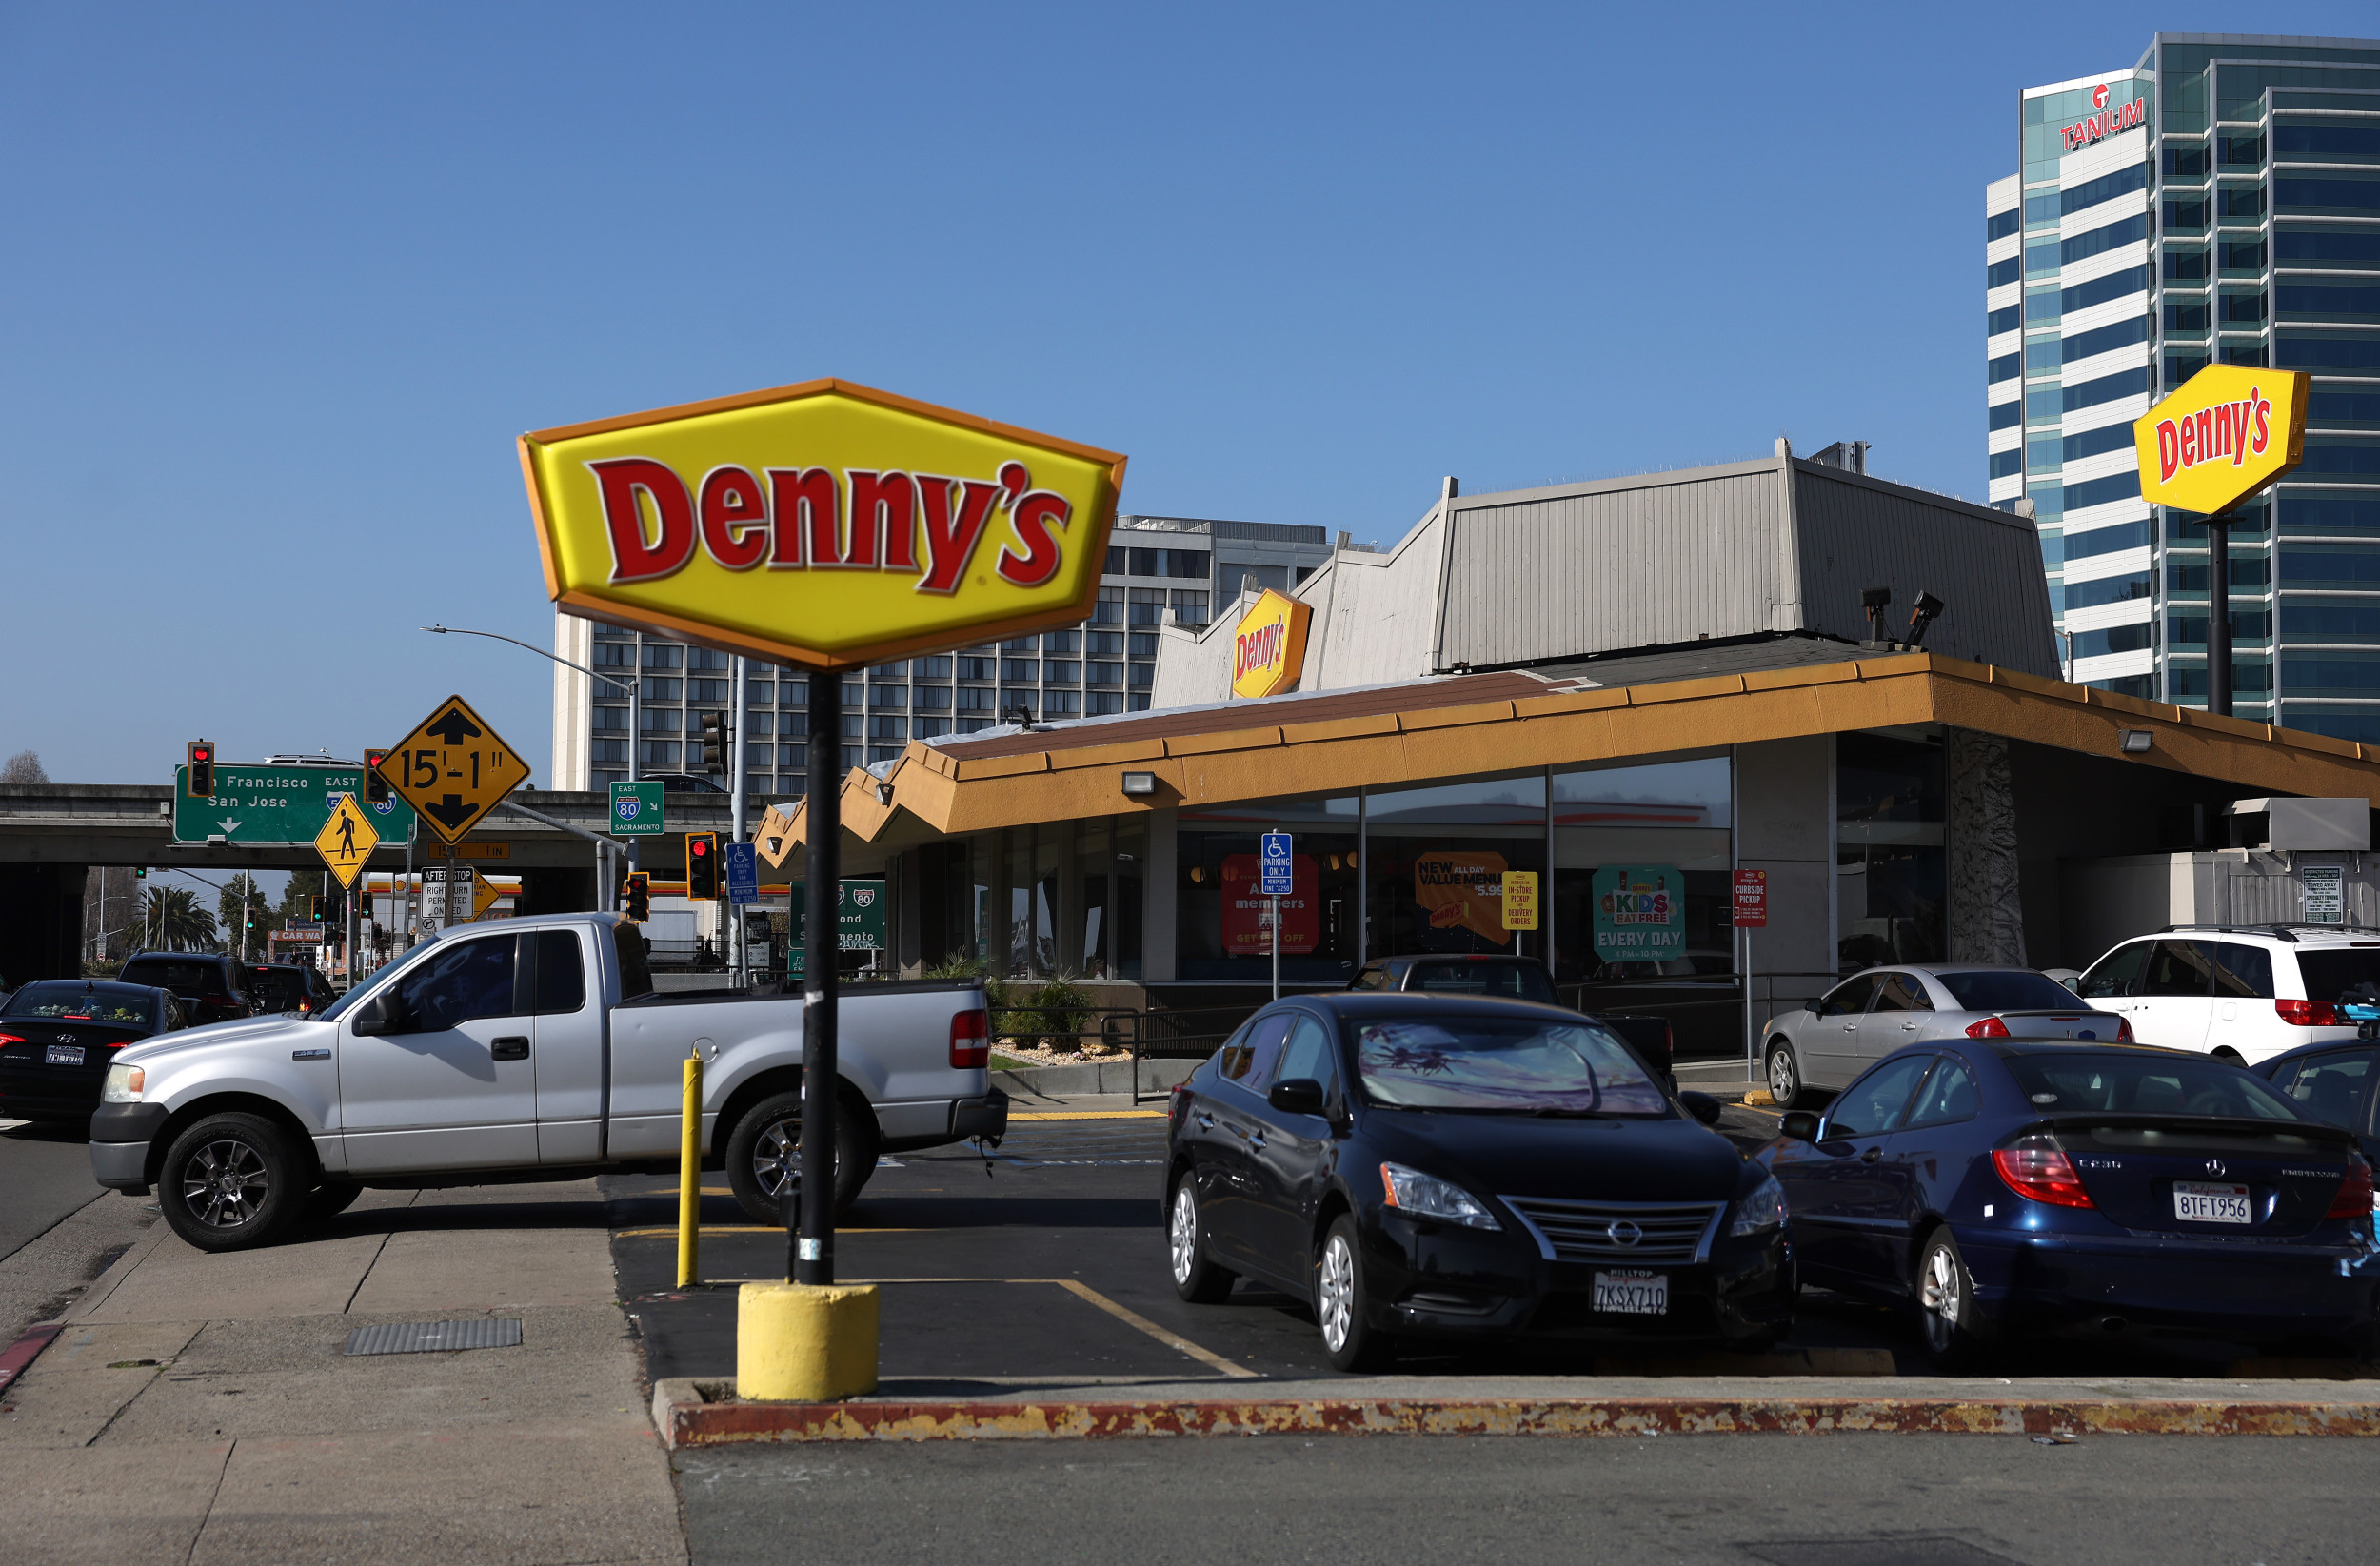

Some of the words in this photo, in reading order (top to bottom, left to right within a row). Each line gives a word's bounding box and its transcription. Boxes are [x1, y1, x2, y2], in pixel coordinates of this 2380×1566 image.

[2060, 96, 2144, 150] TANIUM
[2155, 386, 2271, 485] Denny's
[582, 455, 1072, 596] Denny's
[1236, 613, 1285, 683] Denny's
[227, 775, 308, 788] Francisco
[325, 777, 357, 786] EAST
[208, 796, 238, 807] San
[248, 795, 288, 807] Jose
[620, 803, 637, 816] 80
[1264, 858, 1290, 866] PARKING
[1418, 862, 1453, 873] NEW
[1269, 867, 1285, 876] ONLY
[1419, 874, 1461, 885] VALUE
[1463, 874, 1502, 885] MENU
[1735, 885, 1764, 894] CURBSIDE
[858, 895, 870, 903] 80
[1235, 899, 1305, 909] memers
[1616, 894, 1668, 913] KIDS
[1739, 895, 1760, 904] PICKUP
[1616, 913, 1637, 923] EAT
[1638, 913, 1667, 922] FREE
[1236, 934, 1256, 942] GET
[1285, 934, 1305, 942] OFF
[1598, 931, 1647, 946] EVERY
[1651, 931, 1681, 947] DAY
[2180, 1196, 2246, 1218] 8TFT956
[1611, 1269, 1654, 1278] HILLTOP
[1597, 1285, 1665, 1310] 7KSX710
